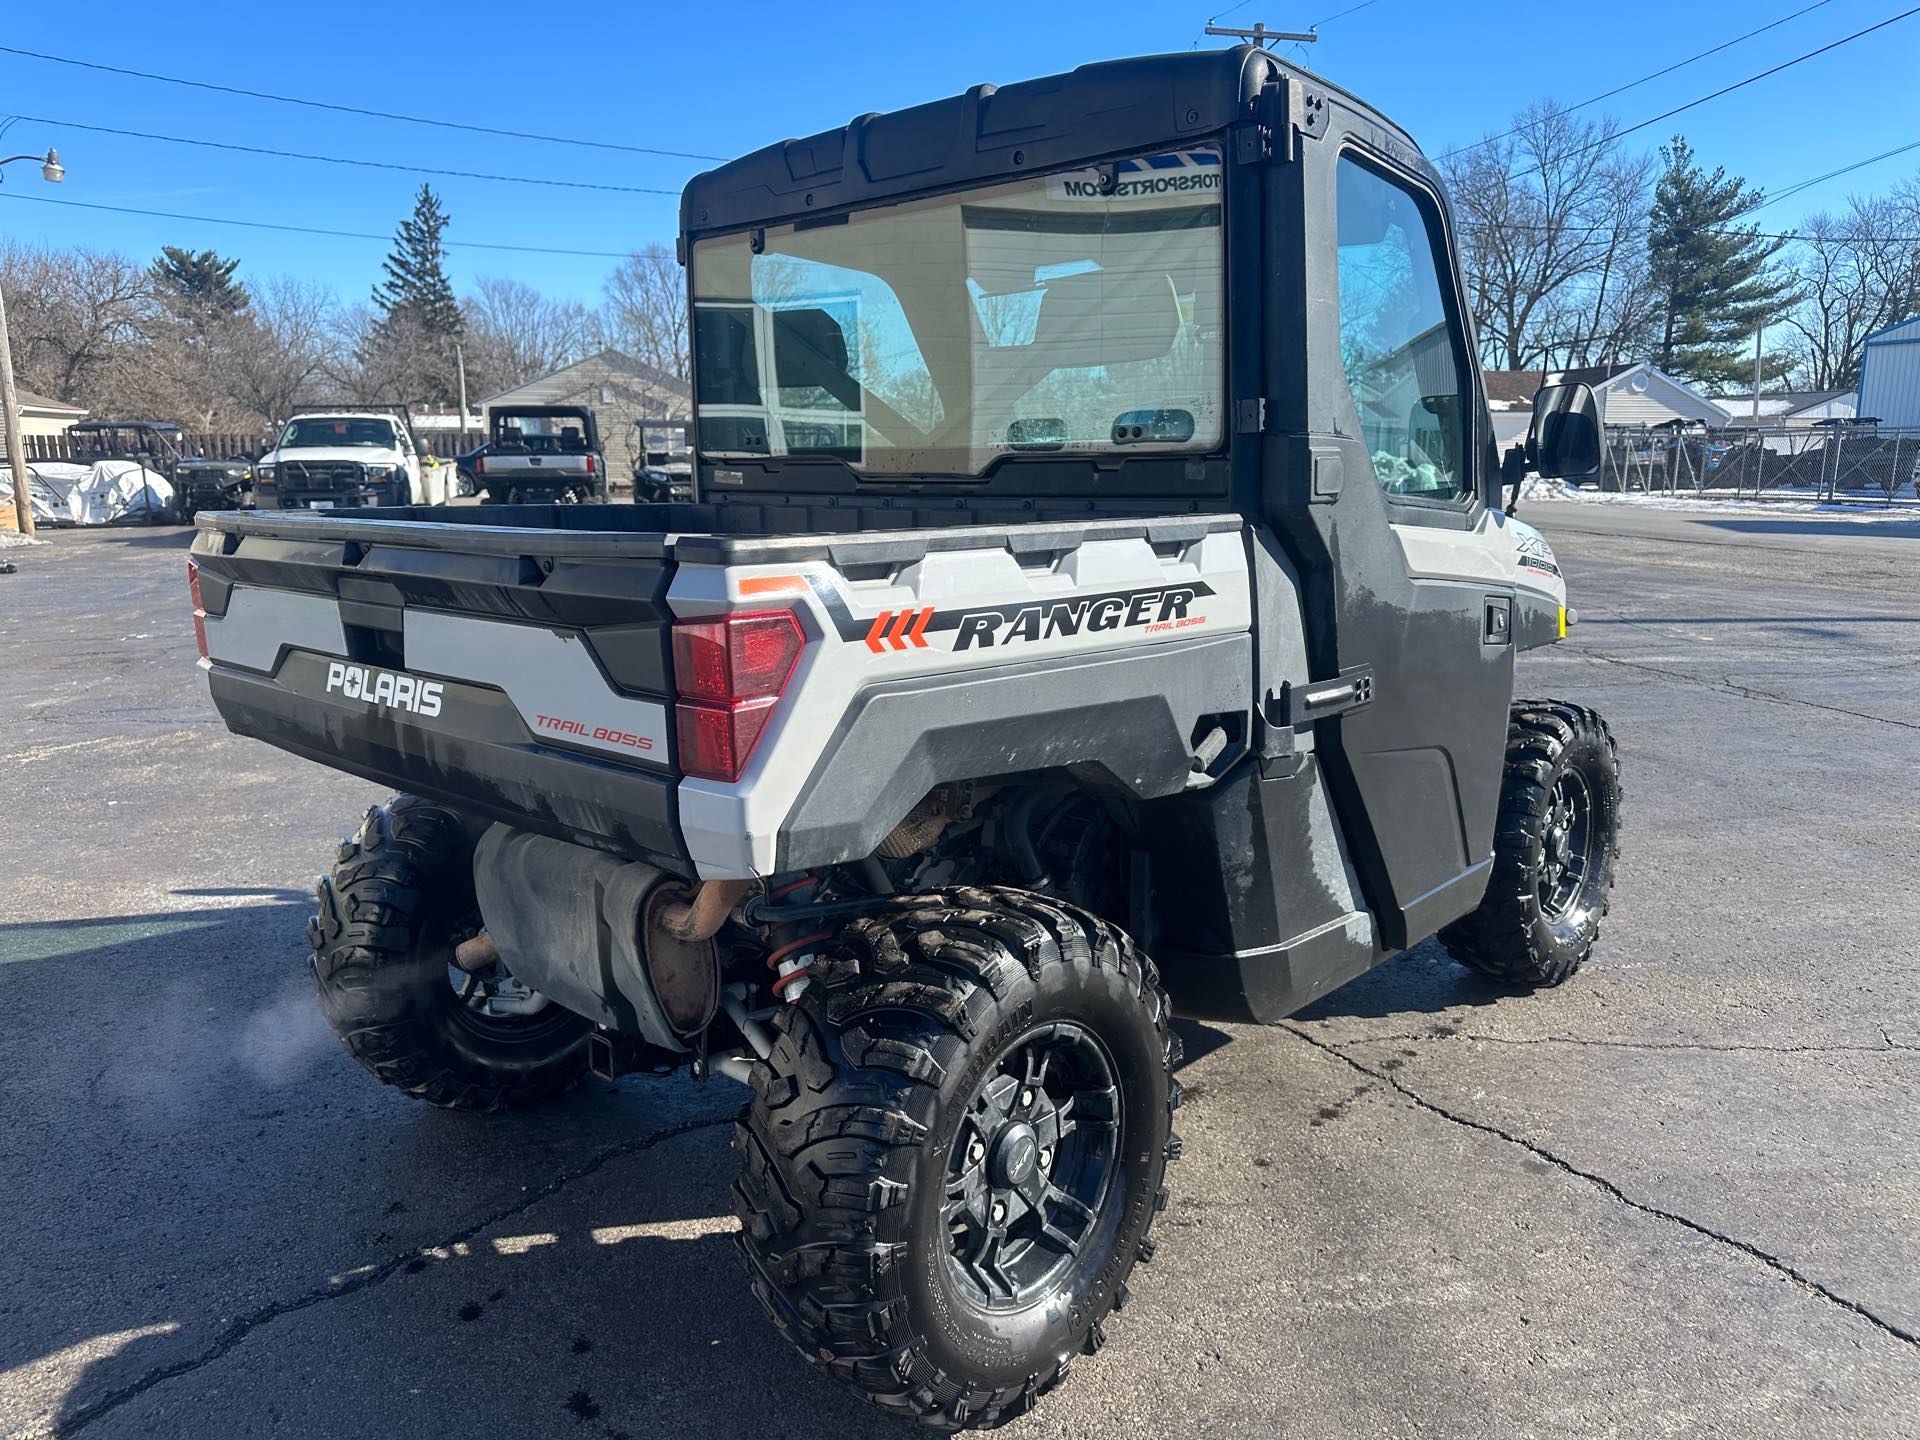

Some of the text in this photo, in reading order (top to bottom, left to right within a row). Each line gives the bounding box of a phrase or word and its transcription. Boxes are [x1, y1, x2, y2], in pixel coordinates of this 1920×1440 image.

[1516, 532, 1552, 558] XP
[1526, 556, 1554, 573] 1000
[952, 588, 1195, 651] RANGER
[1143, 615, 1207, 634] TRAIL BOSS
[327, 662, 443, 717] POLARIS
[536, 715, 655, 751] TRAIL BOSS
